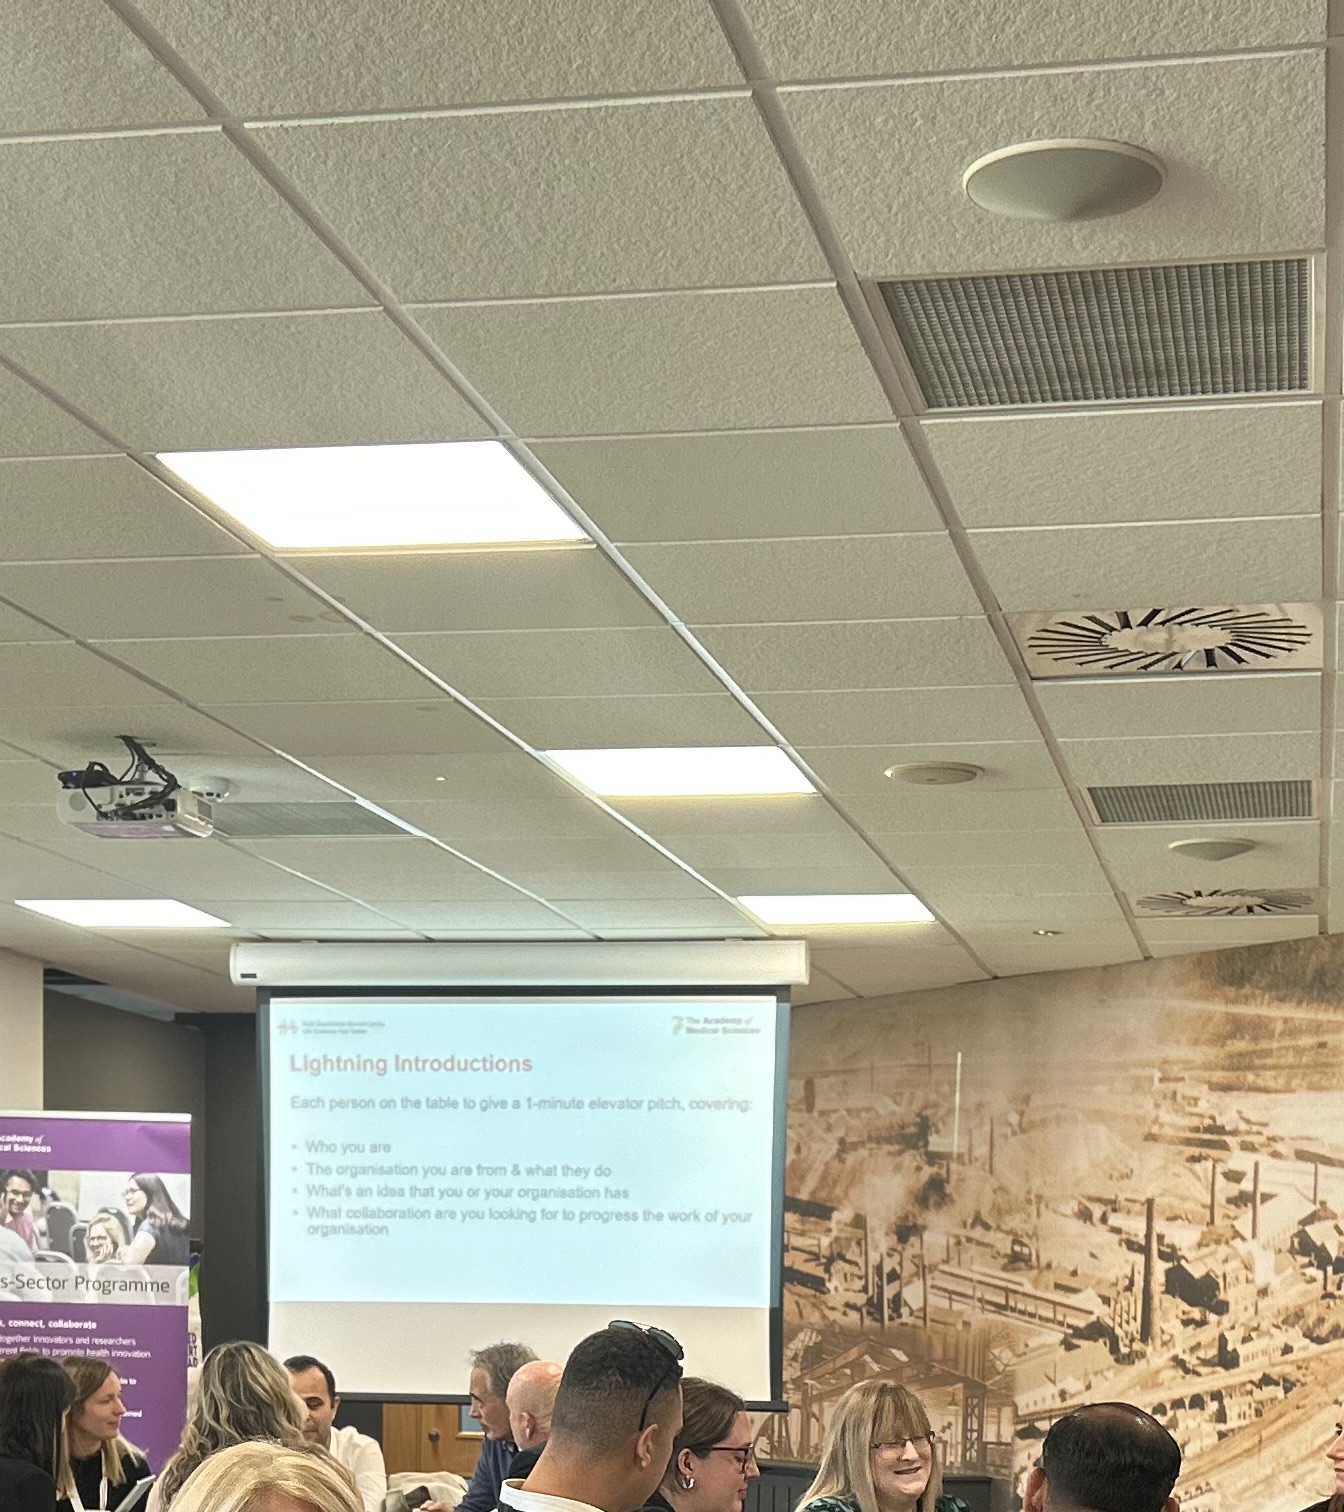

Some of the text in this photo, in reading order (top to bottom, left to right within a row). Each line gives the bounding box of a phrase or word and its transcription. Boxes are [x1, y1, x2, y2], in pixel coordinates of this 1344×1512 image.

[289, 1054, 534, 1077] Lightning Introductions
[290, 1096, 754, 1113] Each person on the table to give a 1-minute elevator pitch, covering:
[13, 1143, 52, 1153] Sciences
[305, 1140, 392, 1156] Who you are
[305, 1162, 612, 1180] The organisation you are from & what they do
[306, 1184, 629, 1202] What's an idea that you or your organisation has
[306, 1206, 754, 1225] What collaboration are you looking for to progress the work of your
[307, 1223, 390, 1238] organisation
[74, 1275, 171, 1297] Programme
[8, 1318, 46, 1330] connect,
[47, 1318, 98, 1330] collaborate
[33, 1334, 74, 1345] innovators
[75, 1334, 91, 1346] and
[92, 1335, 137, 1347] researchers
[52, 1348, 85, 1358] promote
[86, 1347, 110, 1358] health
[111, 1348, 152, 1360] innovation
